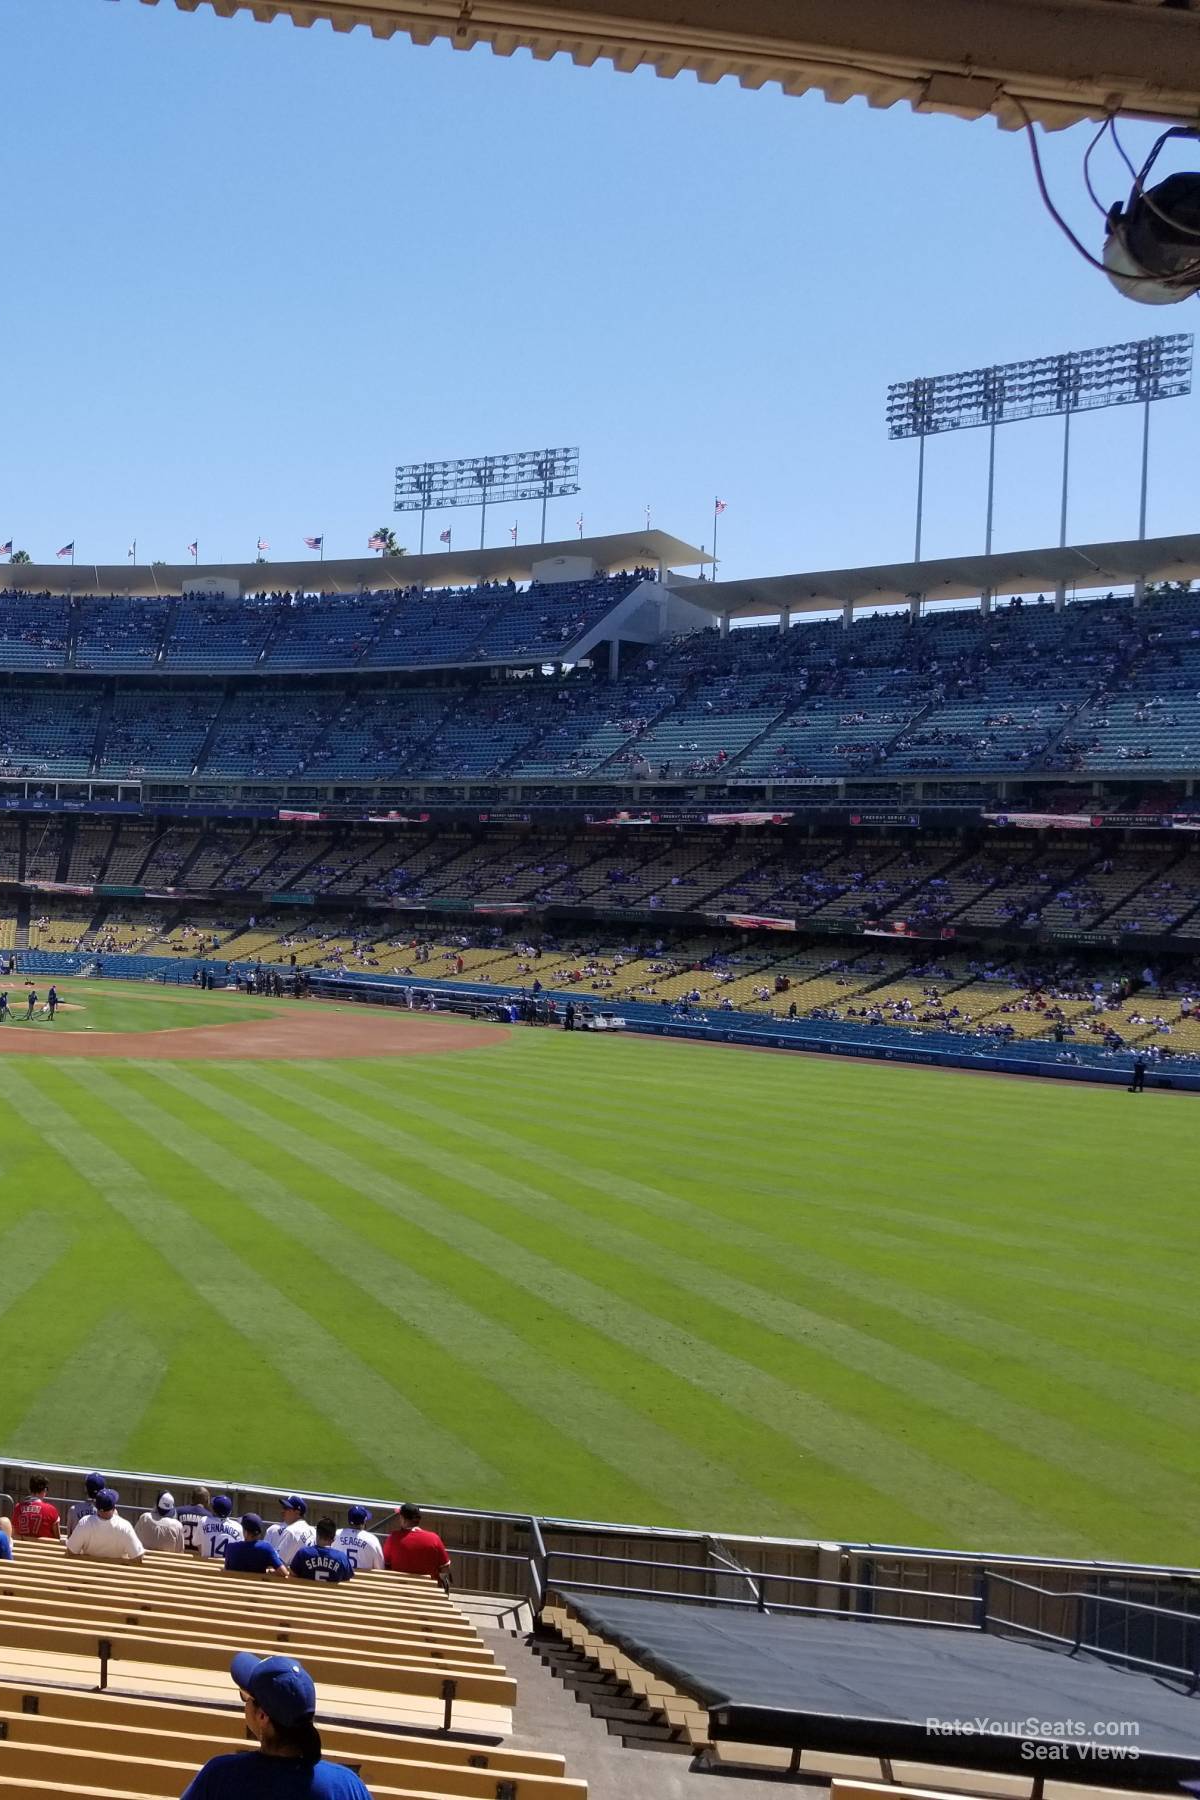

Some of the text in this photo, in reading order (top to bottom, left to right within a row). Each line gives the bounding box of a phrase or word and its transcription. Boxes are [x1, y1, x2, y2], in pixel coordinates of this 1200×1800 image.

[18, 1513, 43, 1535] 27
[210, 1535, 229, 1558] 14
[340, 1536, 368, 1549] SEAGER
[305, 1556, 340, 1572] SEAGER
[347, 1548, 358, 1569] 5
